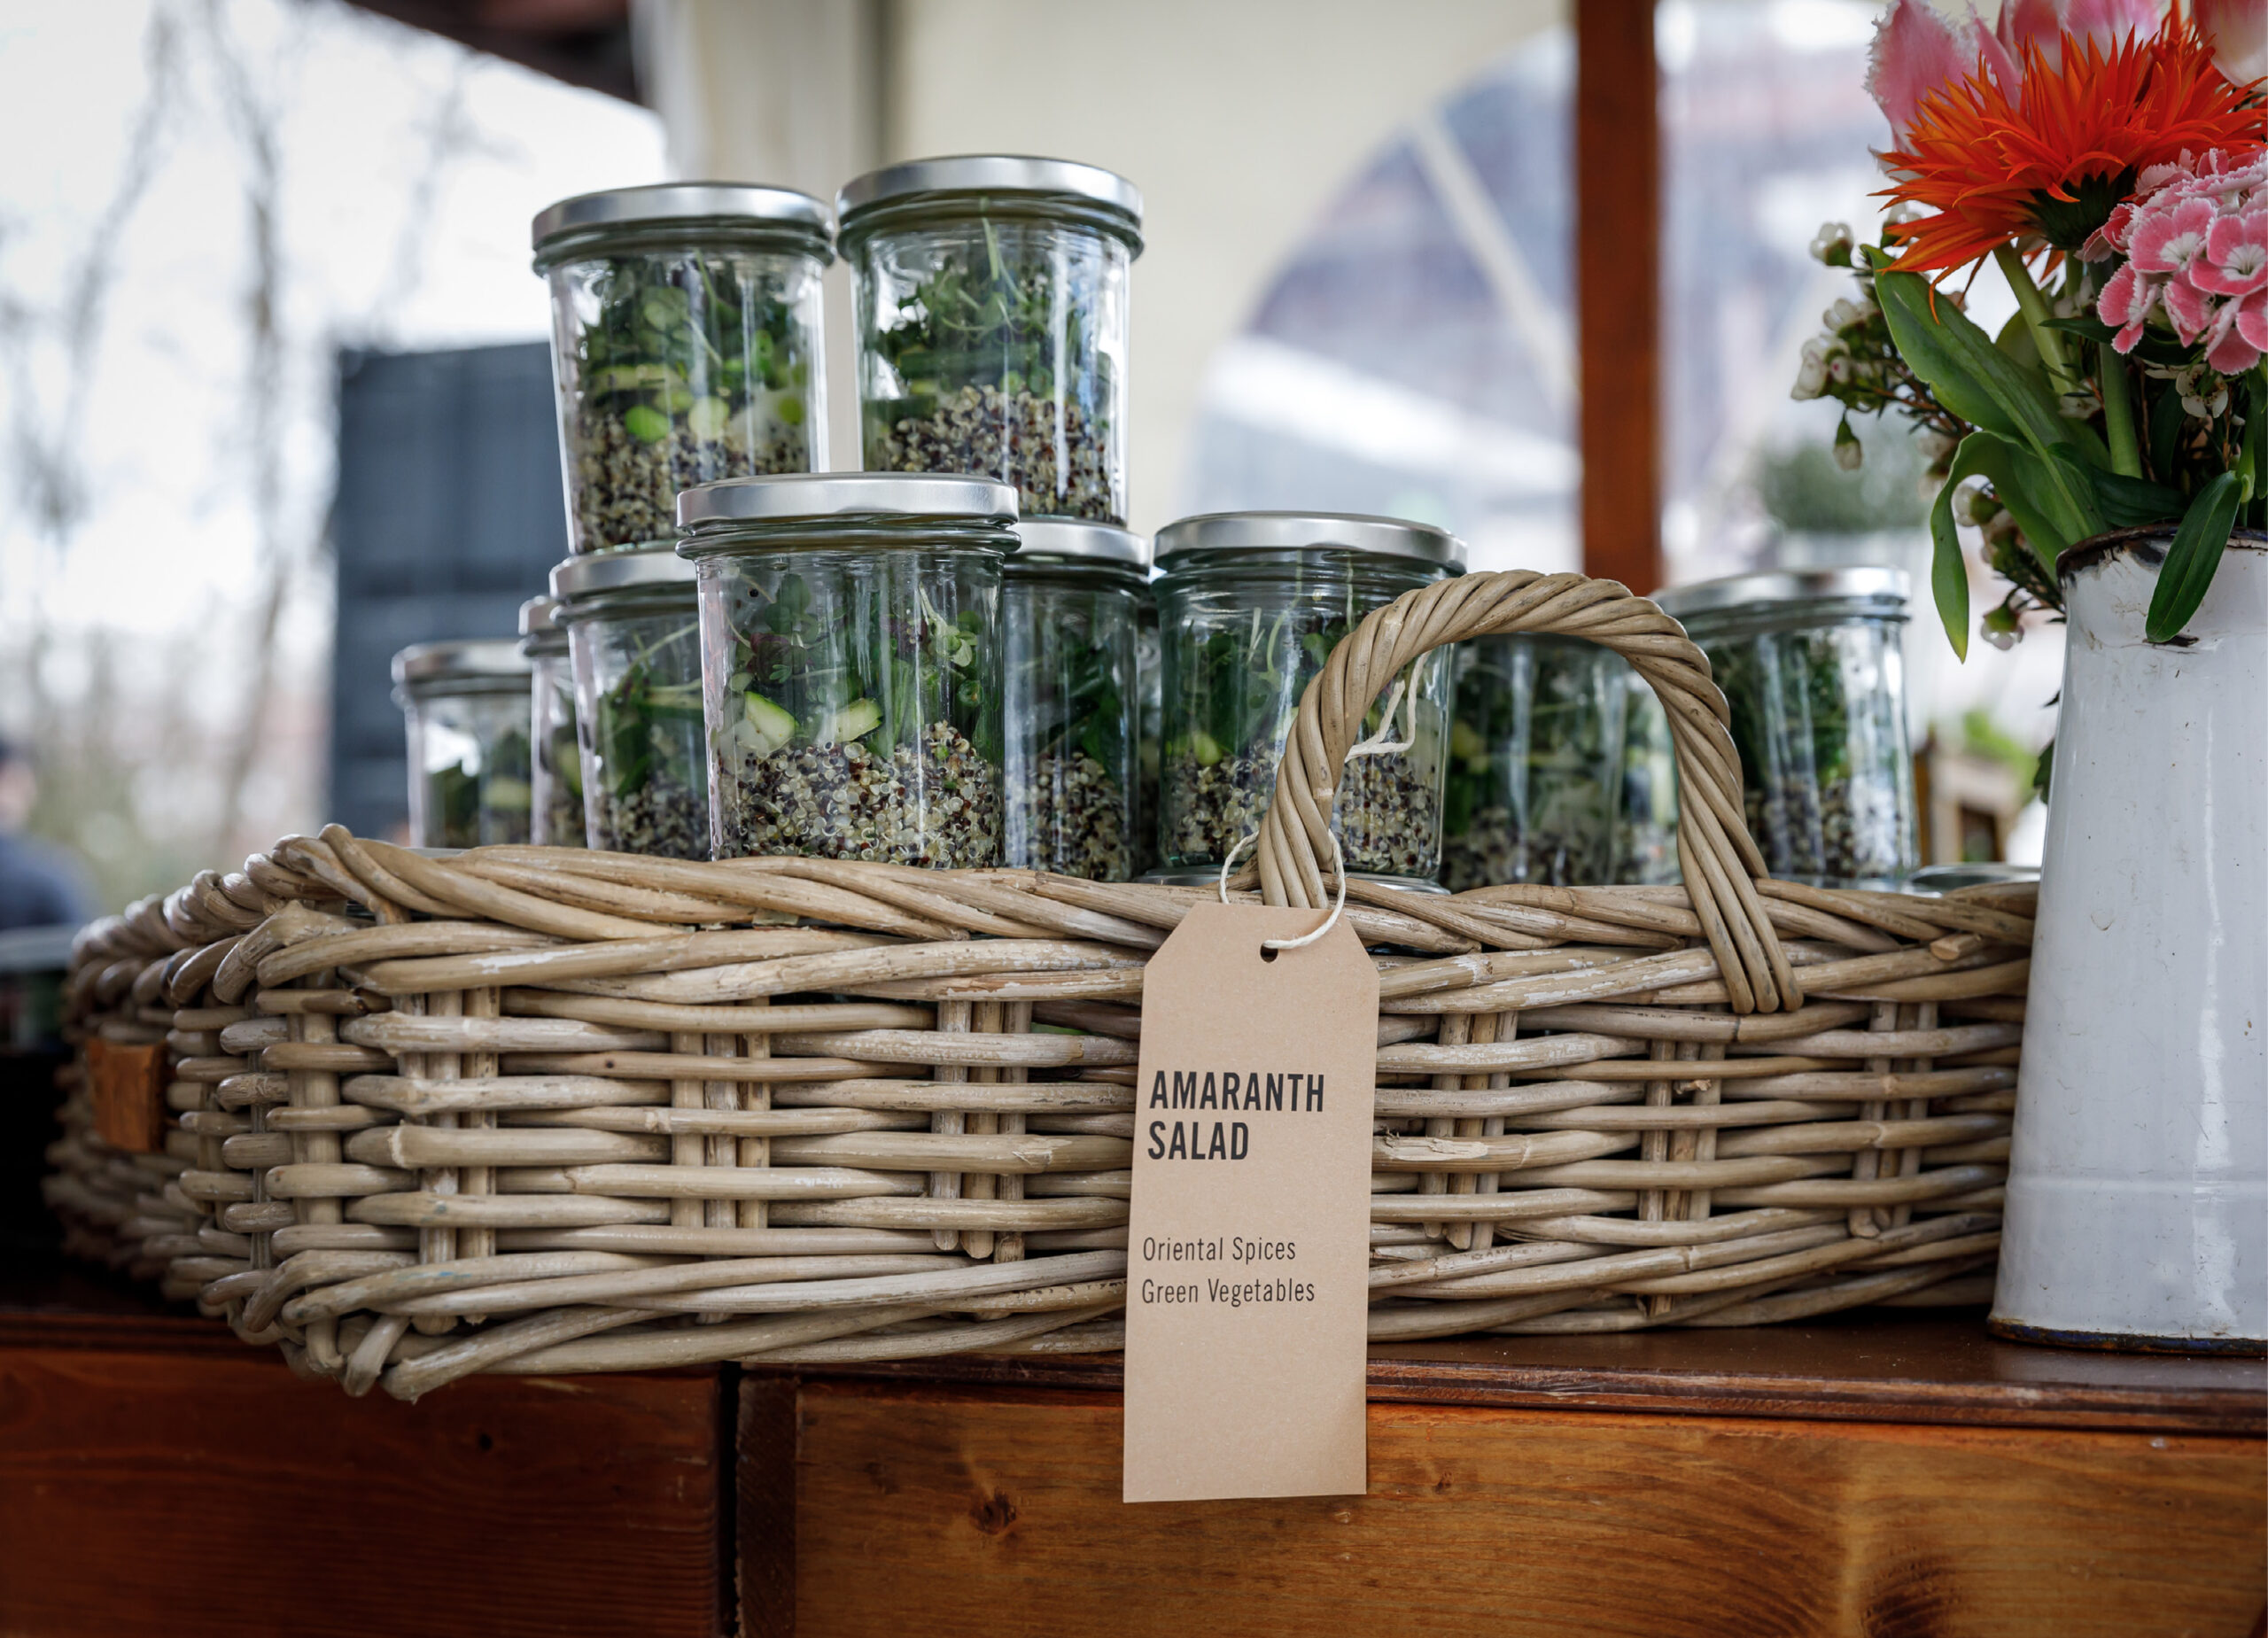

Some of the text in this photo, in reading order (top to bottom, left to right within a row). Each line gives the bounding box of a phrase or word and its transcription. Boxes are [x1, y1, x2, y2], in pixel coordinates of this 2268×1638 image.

[1149, 1070, 1324, 1113] AMARANTH
[1147, 1121, 1249, 1161] SALAD
[1143, 1237, 1296, 1265] Oriental Spices
[1142, 1277, 1315, 1308] Green Vegetables
